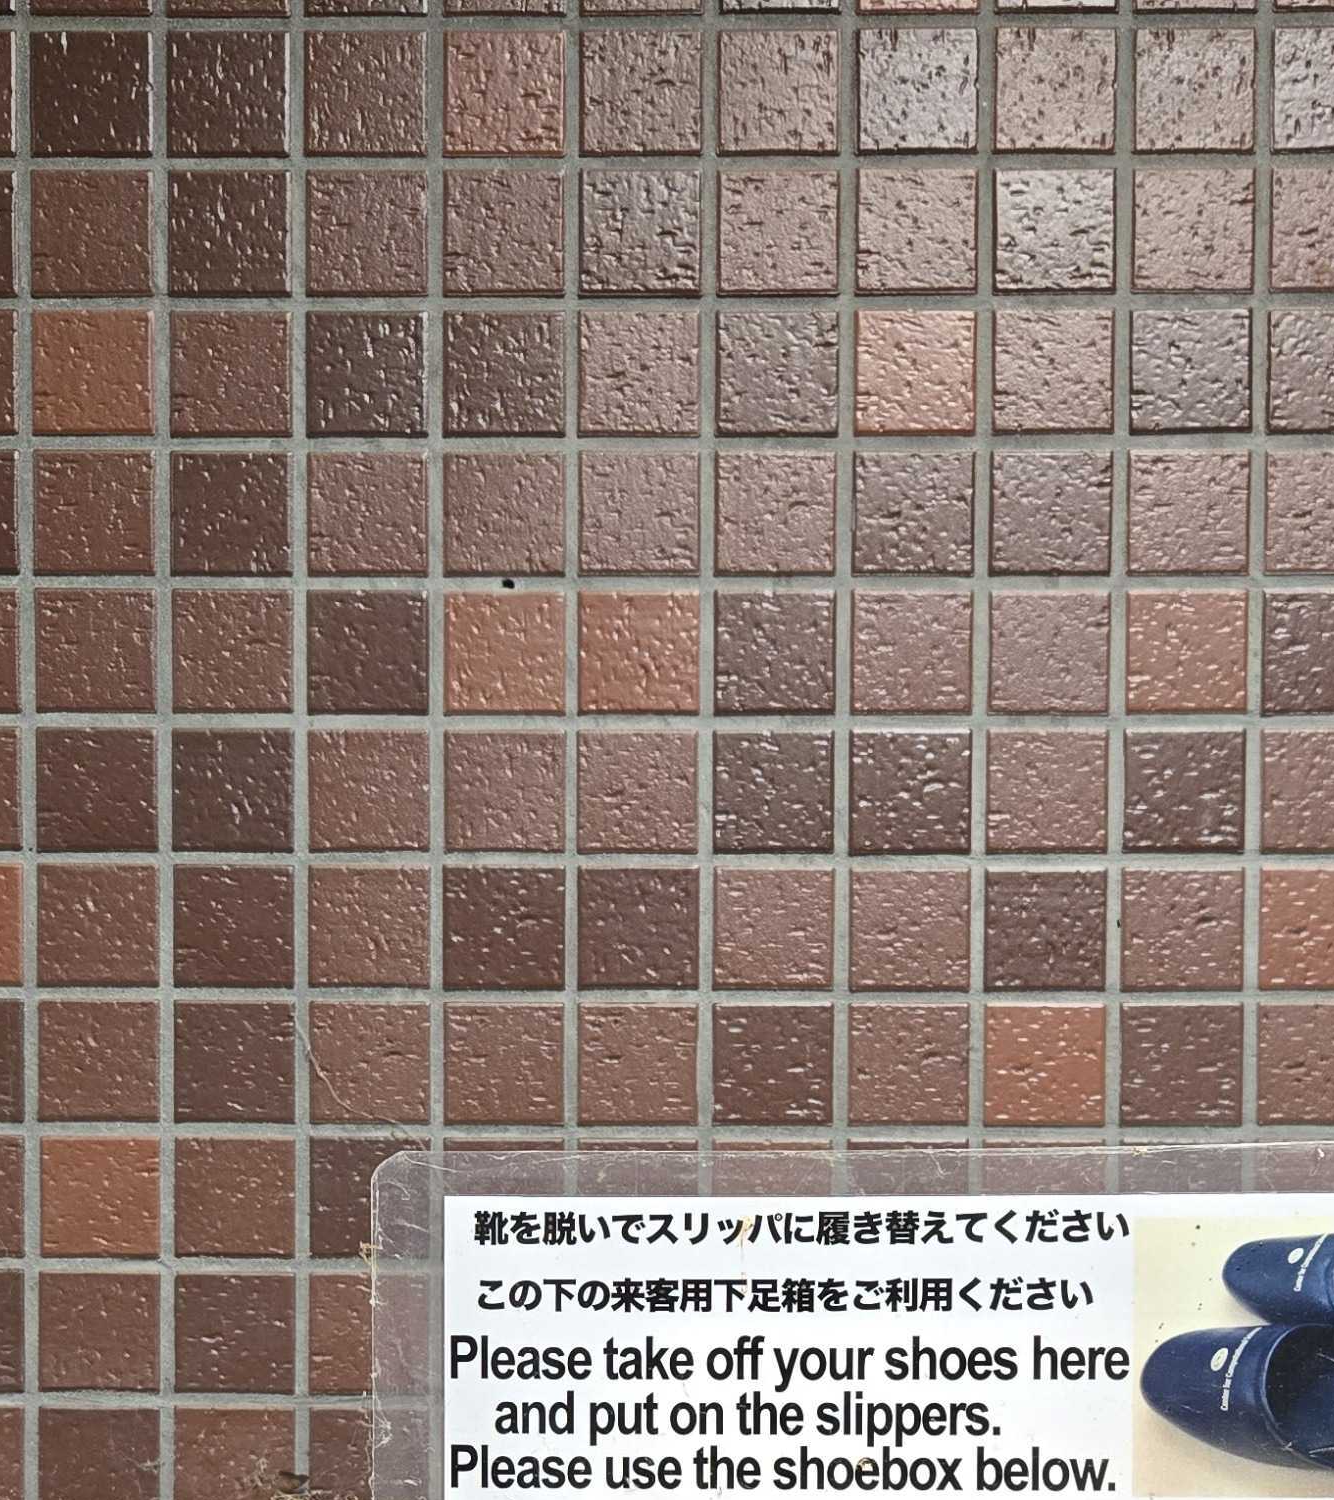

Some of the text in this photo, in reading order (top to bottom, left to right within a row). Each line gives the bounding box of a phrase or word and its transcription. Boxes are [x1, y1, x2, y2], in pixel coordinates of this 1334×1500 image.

[475, 1209, 1129, 1245] 靴を脱いでスリッパに履き替えてください
[478, 1277, 1092, 1312] この下の来客用下足箱をご利用ください
[451, 1336, 1129, 1394] Please take off your shoes here
[496, 1389, 1000, 1447] and put on the slippers.
[451, 1441, 1115, 1491] Please use the shoebox below.
